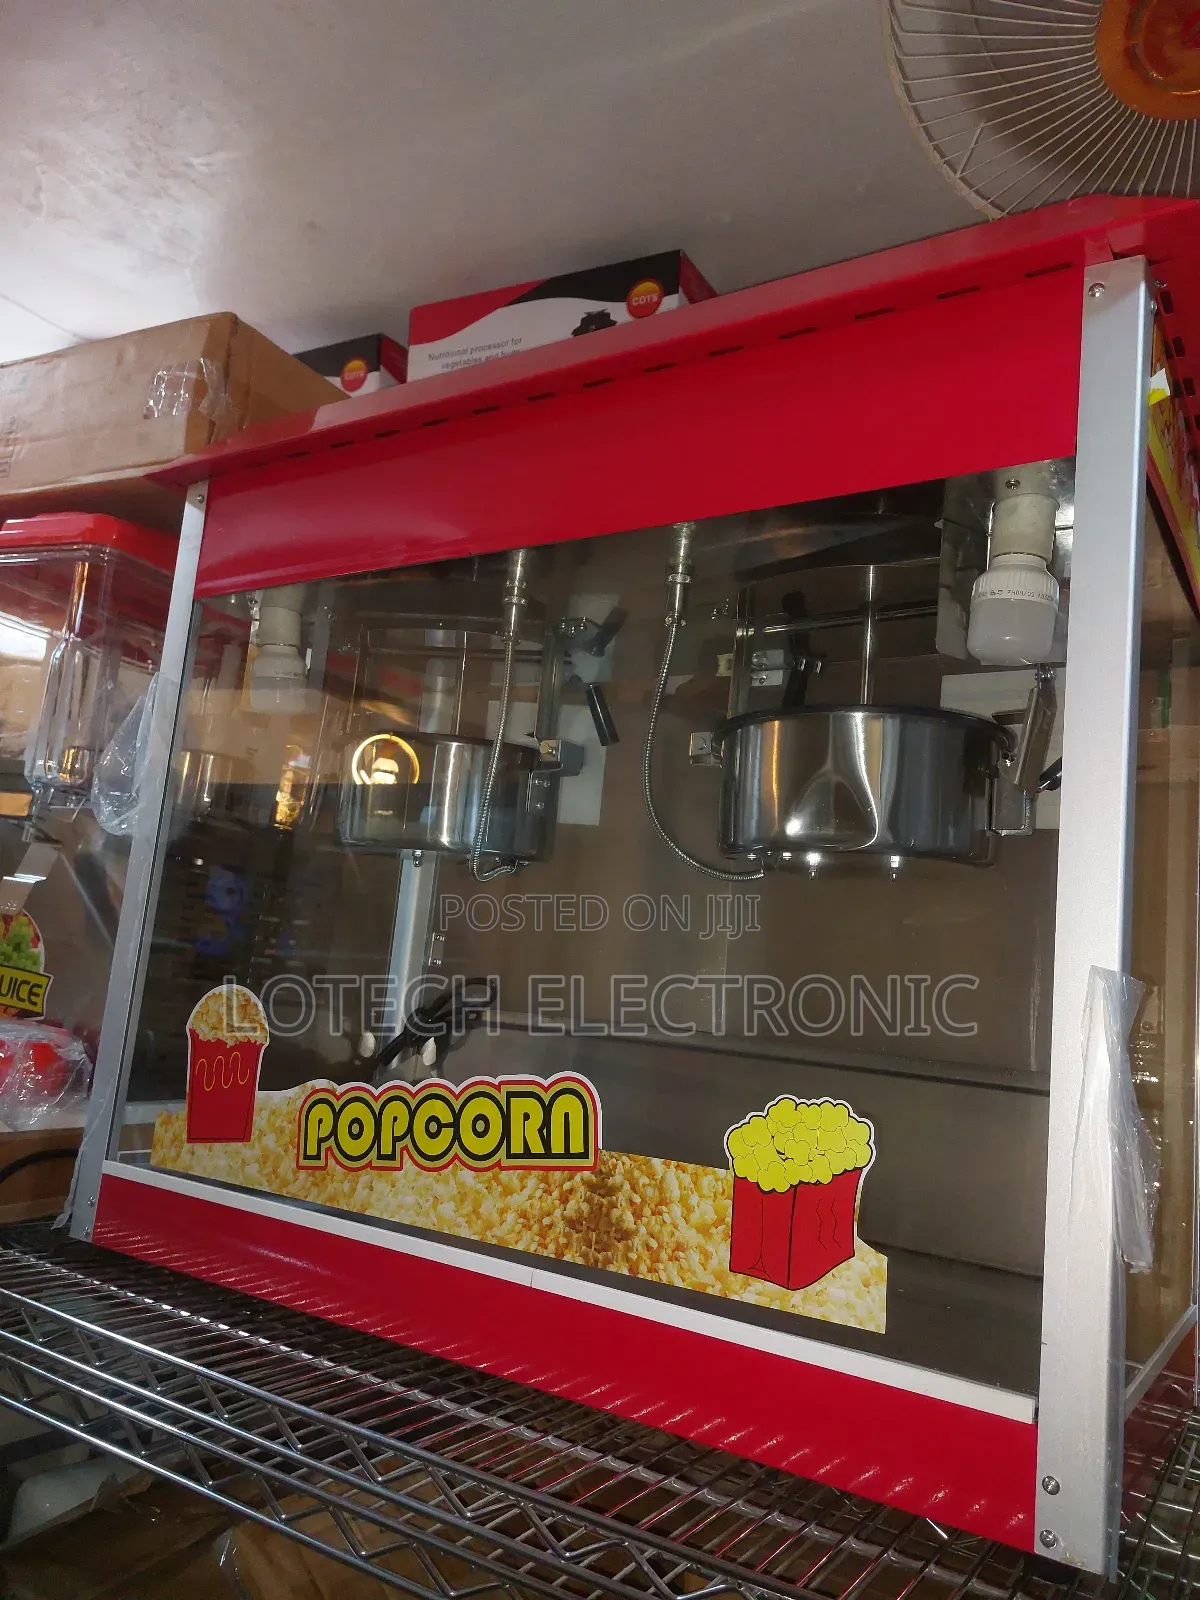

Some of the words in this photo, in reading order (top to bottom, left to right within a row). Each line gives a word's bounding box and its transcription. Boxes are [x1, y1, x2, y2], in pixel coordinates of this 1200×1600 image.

[632, 294, 659, 306] COTS
[428, 347, 469, 361] Nutritional
[470, 340, 510, 355] processor
[511, 337, 523, 346] for
[303, 1087, 590, 1161] POPCORN
